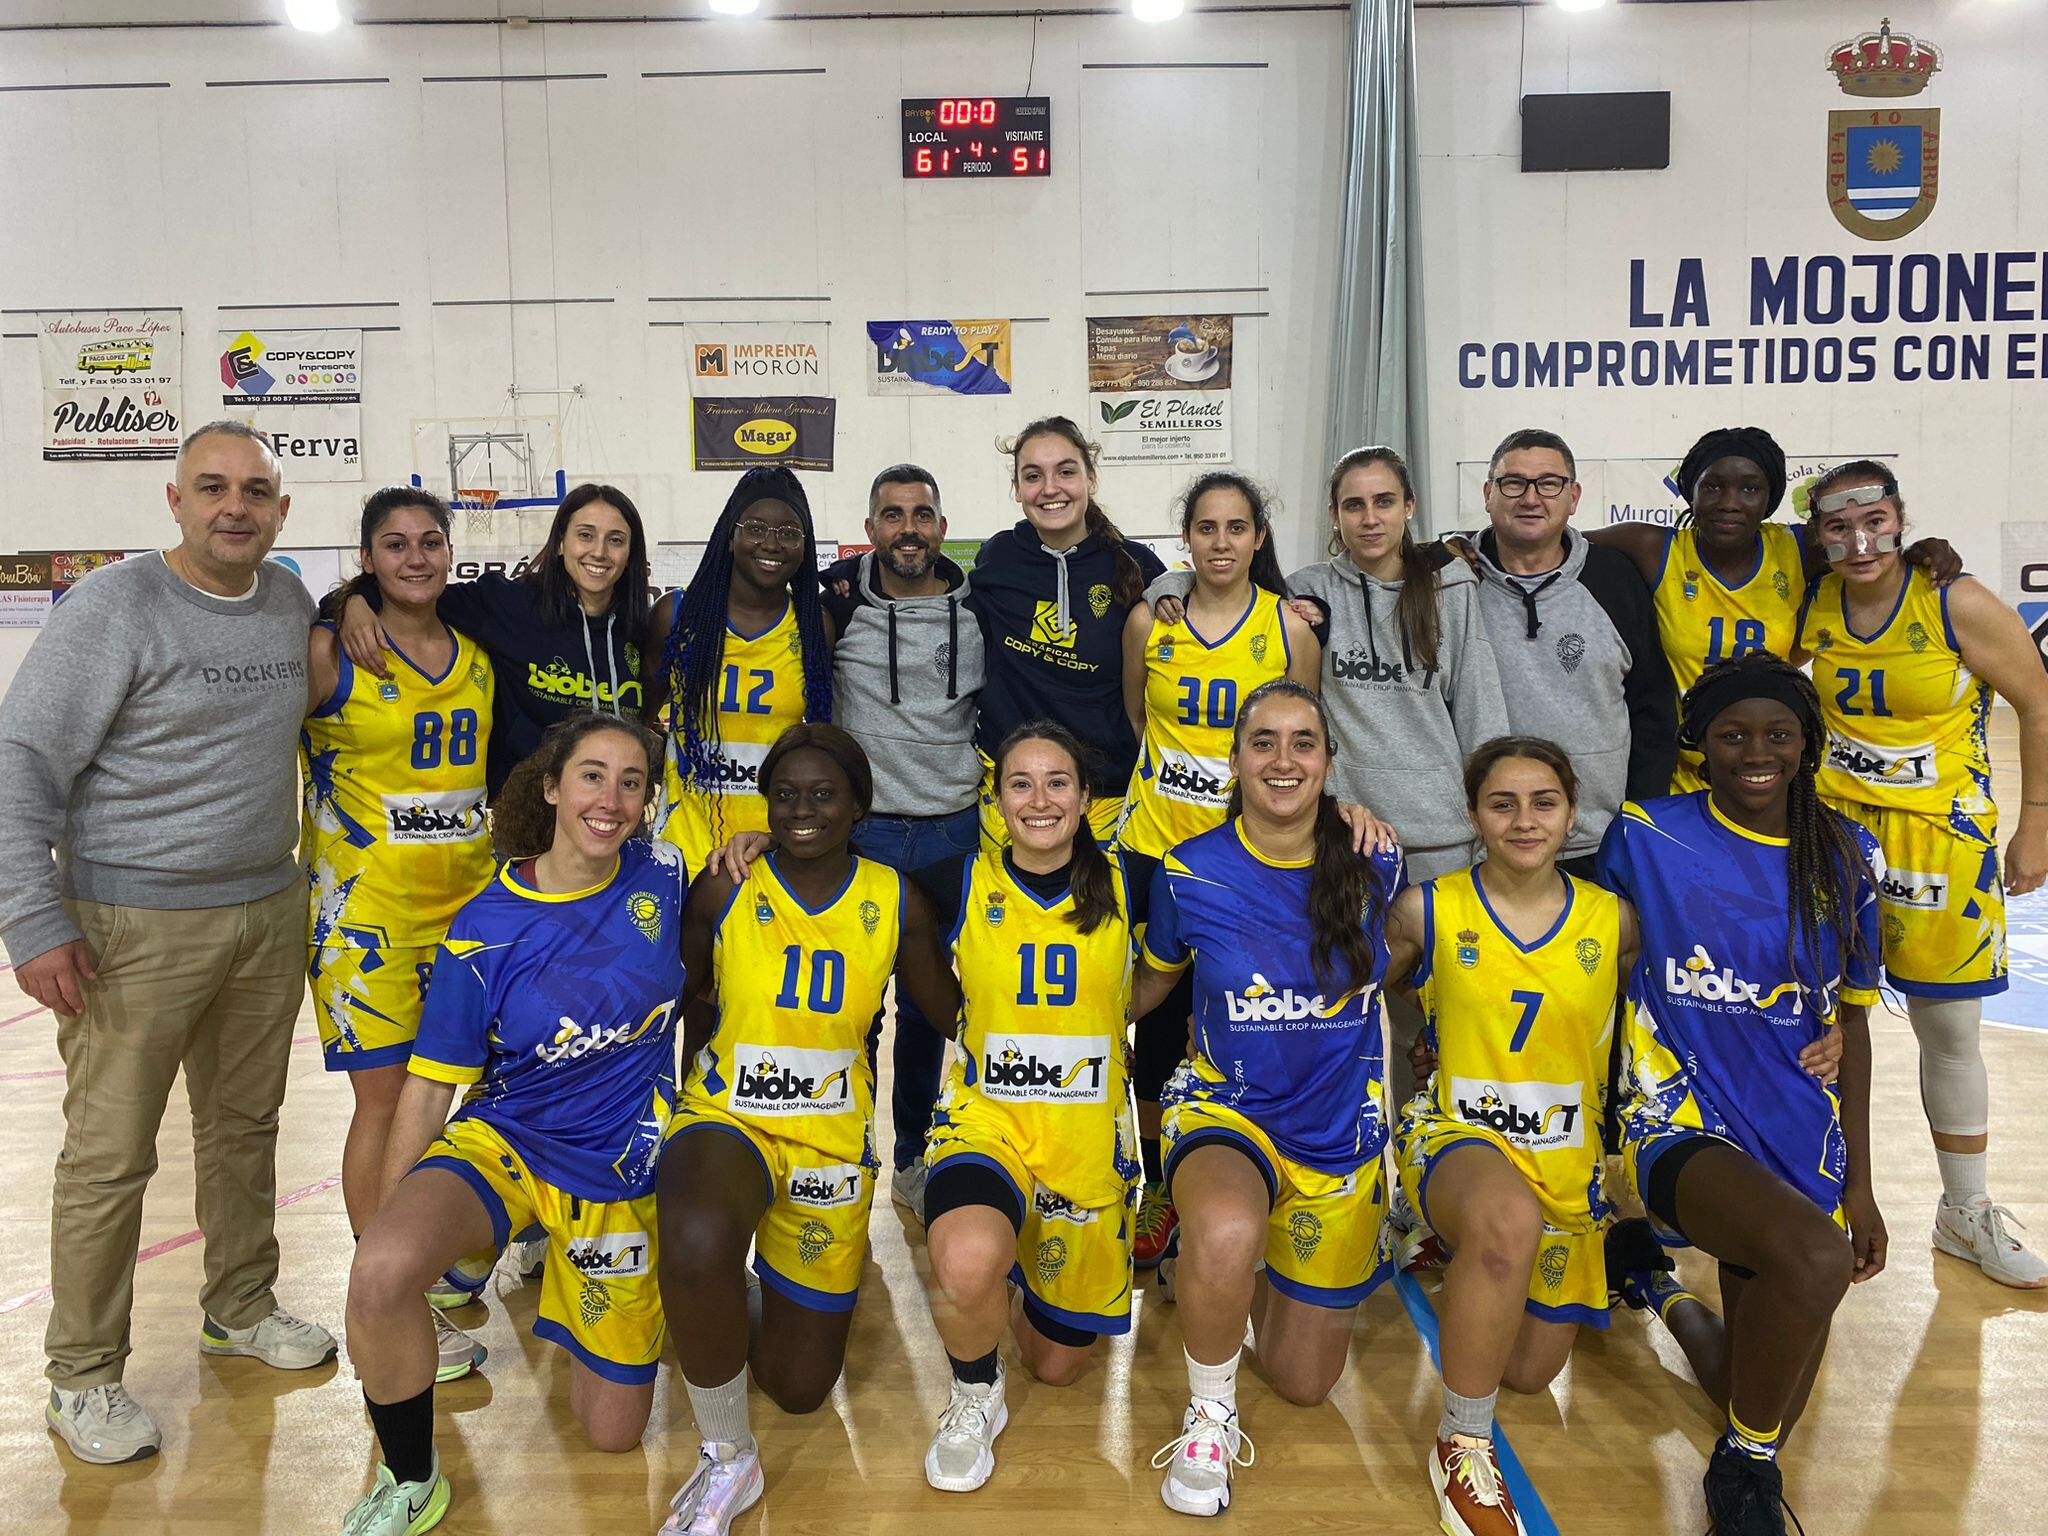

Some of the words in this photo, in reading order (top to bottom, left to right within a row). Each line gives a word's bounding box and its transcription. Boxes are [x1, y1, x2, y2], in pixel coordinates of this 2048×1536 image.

[940, 100, 996, 124] 00:0
[1870, 111, 1902, 126] 10
[909, 133, 947, 143] LOCAL
[1005, 131, 1043, 142] VISITANTE
[971, 142, 982, 157] 4
[917, 149, 949, 172] 61
[1014, 147, 1045, 171] 51
[963, 162, 992, 173] PERIODO
[1629, 258, 1710, 328] LA
[1750, 251, 2048, 325] MOJONE
[45, 319, 101, 334] Autobuses
[104, 318, 134, 333] Paco
[136, 318, 171, 336] López
[921, 325, 952, 335] READY
[955, 326, 967, 335] TO
[970, 325, 999, 335] PLAY?
[1095, 328, 1134, 336] Desayunos
[1096, 345, 1117, 353] Tapas
[1124, 337, 1140, 345] para
[266, 351, 355, 360] COPY&COPY
[734, 344, 817, 357] IMPRENTA
[734, 358, 818, 375] MORÓN
[1459, 336, 1876, 389] COMPROMETIDOS
[1893, 334, 1990, 381] CON
[53, 395, 179, 433] Publiser
[1140, 399, 1161, 418] El
[1166, 400, 1224, 418] Plantel
[1140, 419, 1222, 429] SEMILLEROS
[97, 437, 139, 445] Rotulaciones
[149, 437, 178, 445] Imprenta
[272, 433, 358, 457] Ferva
[741, 429, 791, 445] Magar
[1170, 435, 1191, 443] injerto
[1704, 617, 1765, 664] 18
[1004, 636, 1043, 658] COPY
[1057, 657, 1099, 673] COPY
[720, 664, 774, 714] 12
[1835, 667, 1893, 717] 21
[1177, 676, 1237, 728] 30
[411, 708, 478, 769] 88
[775, 945, 845, 1014] 10
[1016, 943, 1077, 1006] 19
[1667, 995, 1723, 1013] SUSTAINABLE
[1230, 1024, 1283, 1032] SUSTAINABLE
[1286, 1023, 1309, 1031] CROP
[1311, 1018, 1368, 1030] MANAGEMENT
[1509, 989, 1544, 1052] 7
[985, 1087, 1028, 1097] SUSTAINABLE
[1028, 1089, 1048, 1097] CROP
[1049, 1090, 1098, 1098] MANAGEMENT
[735, 1099, 780, 1110] SUSTAINABLE
[782, 1102, 799, 1110] CROP
[801, 1100, 845, 1110] MANAGEMENT
[1509, 1135, 1530, 1145] CROP
[1532, 1135, 1570, 1146] MANAGEMENT
[605, 1267, 639, 1275] MANAGEMENT
